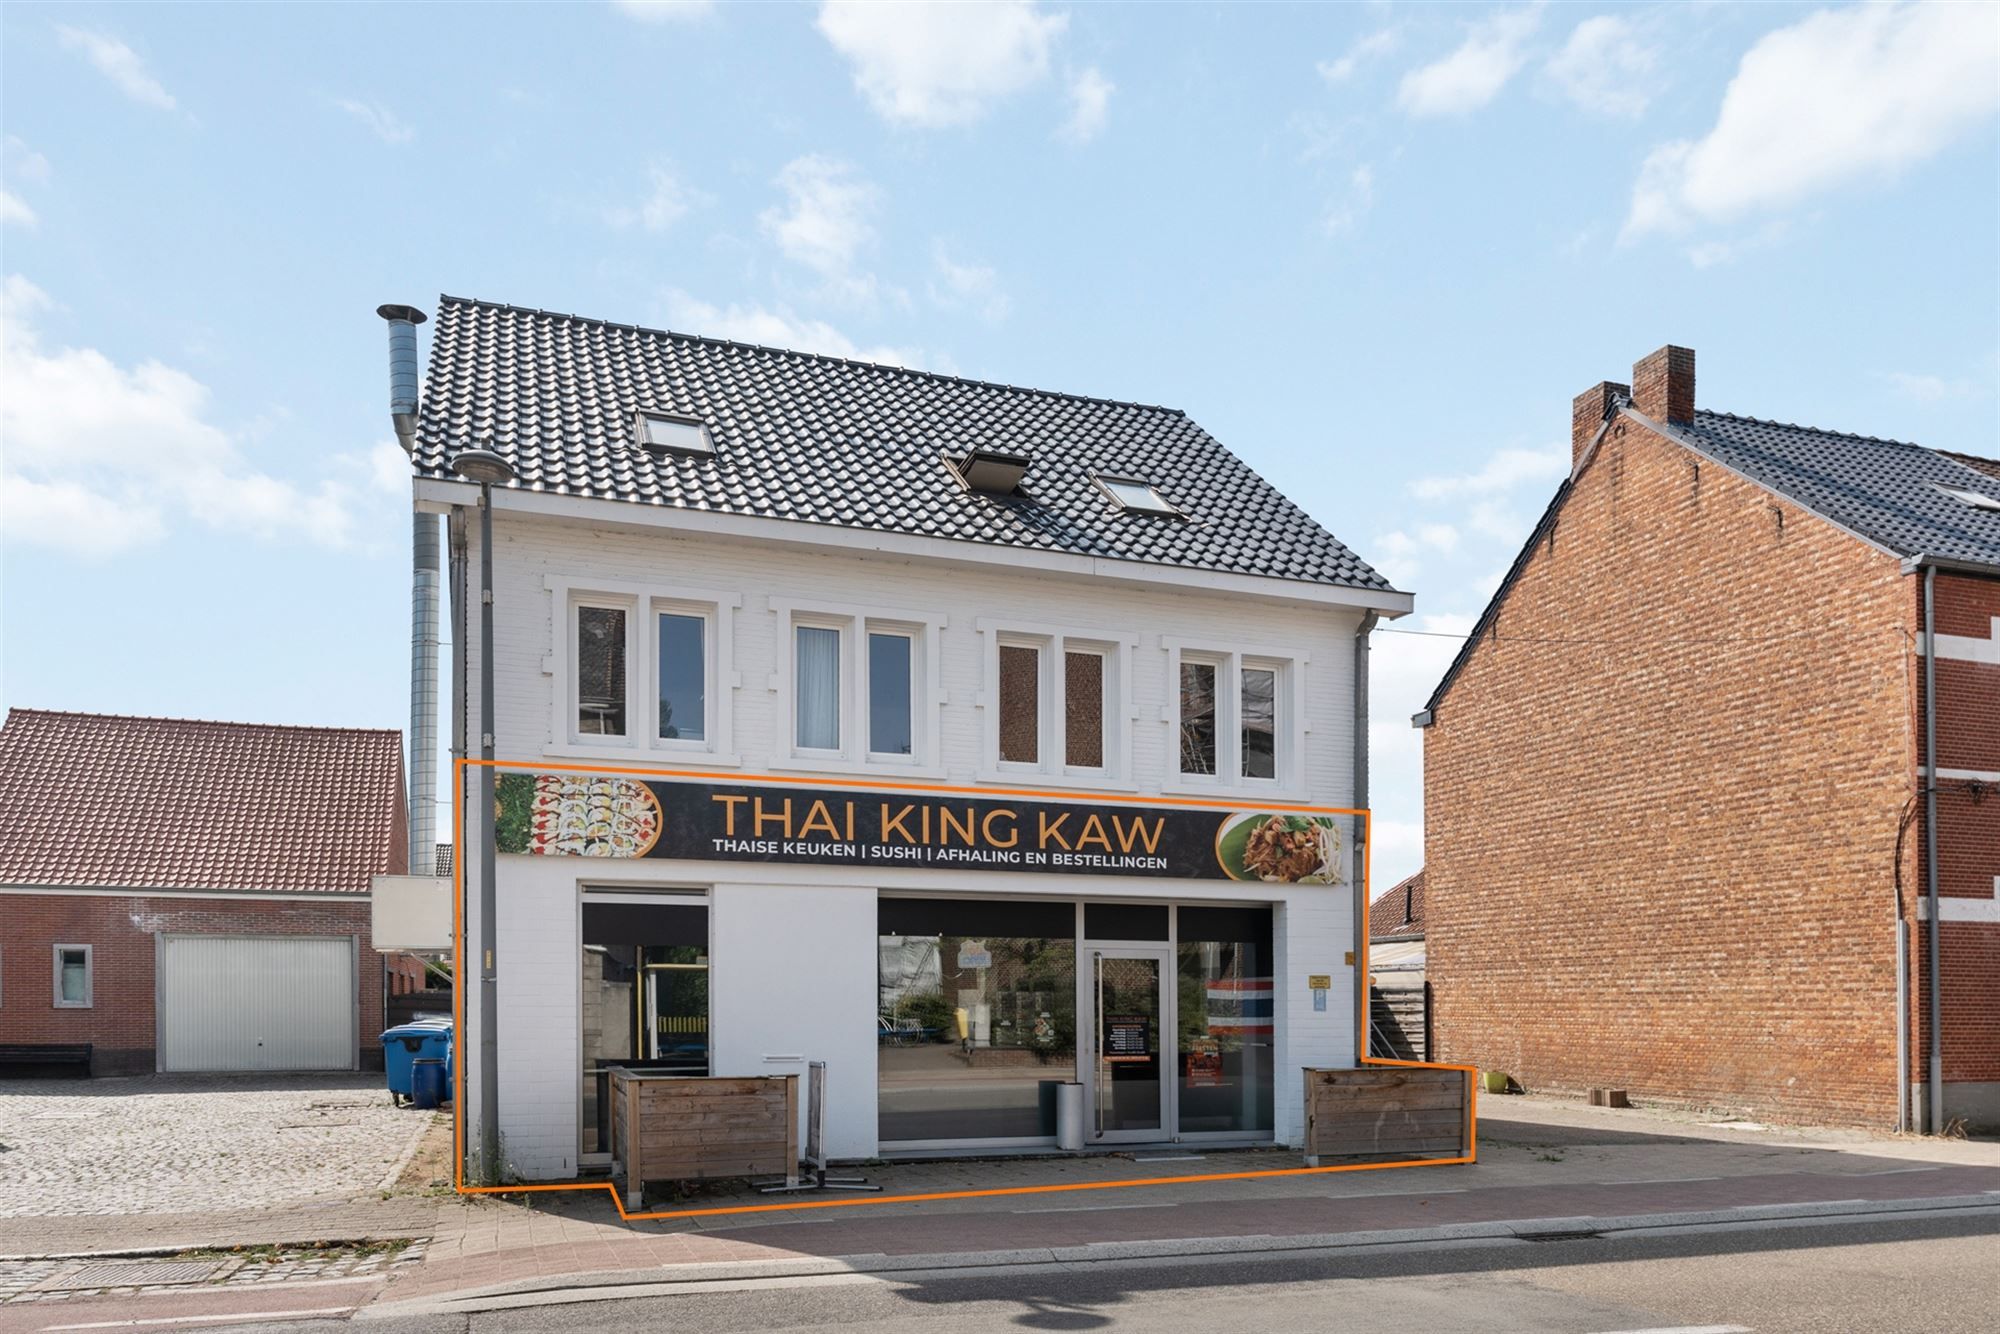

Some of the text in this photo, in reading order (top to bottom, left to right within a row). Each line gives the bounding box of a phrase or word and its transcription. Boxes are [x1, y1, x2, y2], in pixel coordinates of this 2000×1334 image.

[712, 794, 1165, 854] THAI KING KAW
[712, 838, 779, 854] THAISE
[783, 842, 856, 857] KEUKEN
[871, 845, 922, 860] SUSHI
[936, 848, 1021, 864] AFHALING
[1025, 852, 1047, 864] EN
[1052, 853, 1168, 870] BESTELLINGEN
